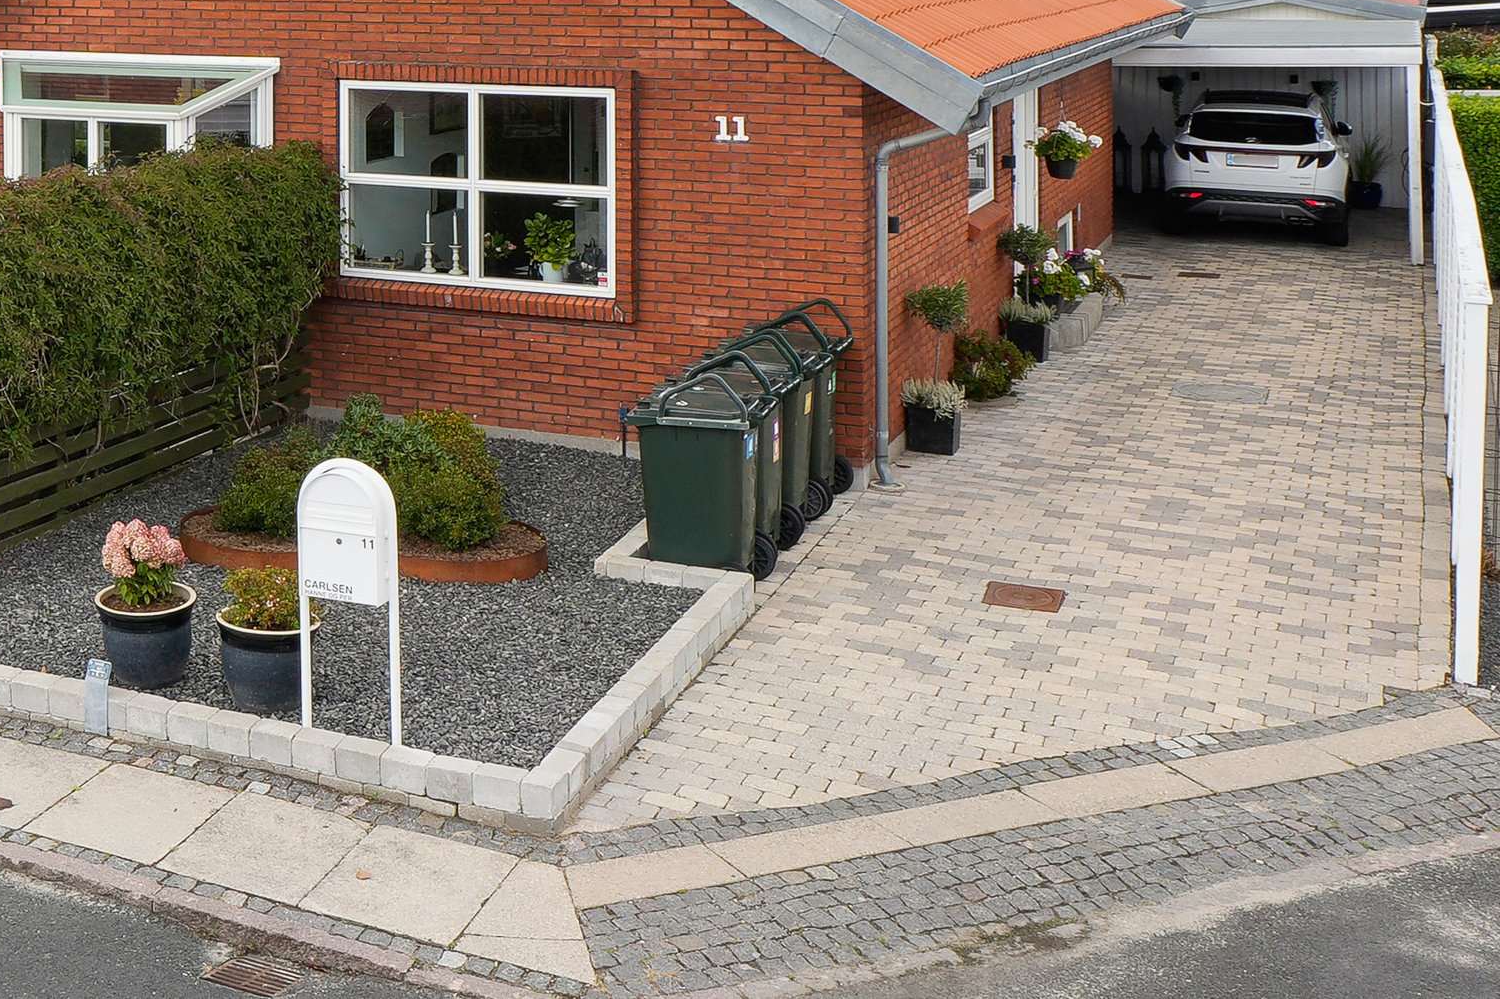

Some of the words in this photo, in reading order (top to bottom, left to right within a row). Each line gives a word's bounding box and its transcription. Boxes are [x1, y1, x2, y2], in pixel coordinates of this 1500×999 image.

[714, 115, 750, 142] 11
[361, 538, 374, 550] 11
[304, 578, 353, 594] CARLSEN
